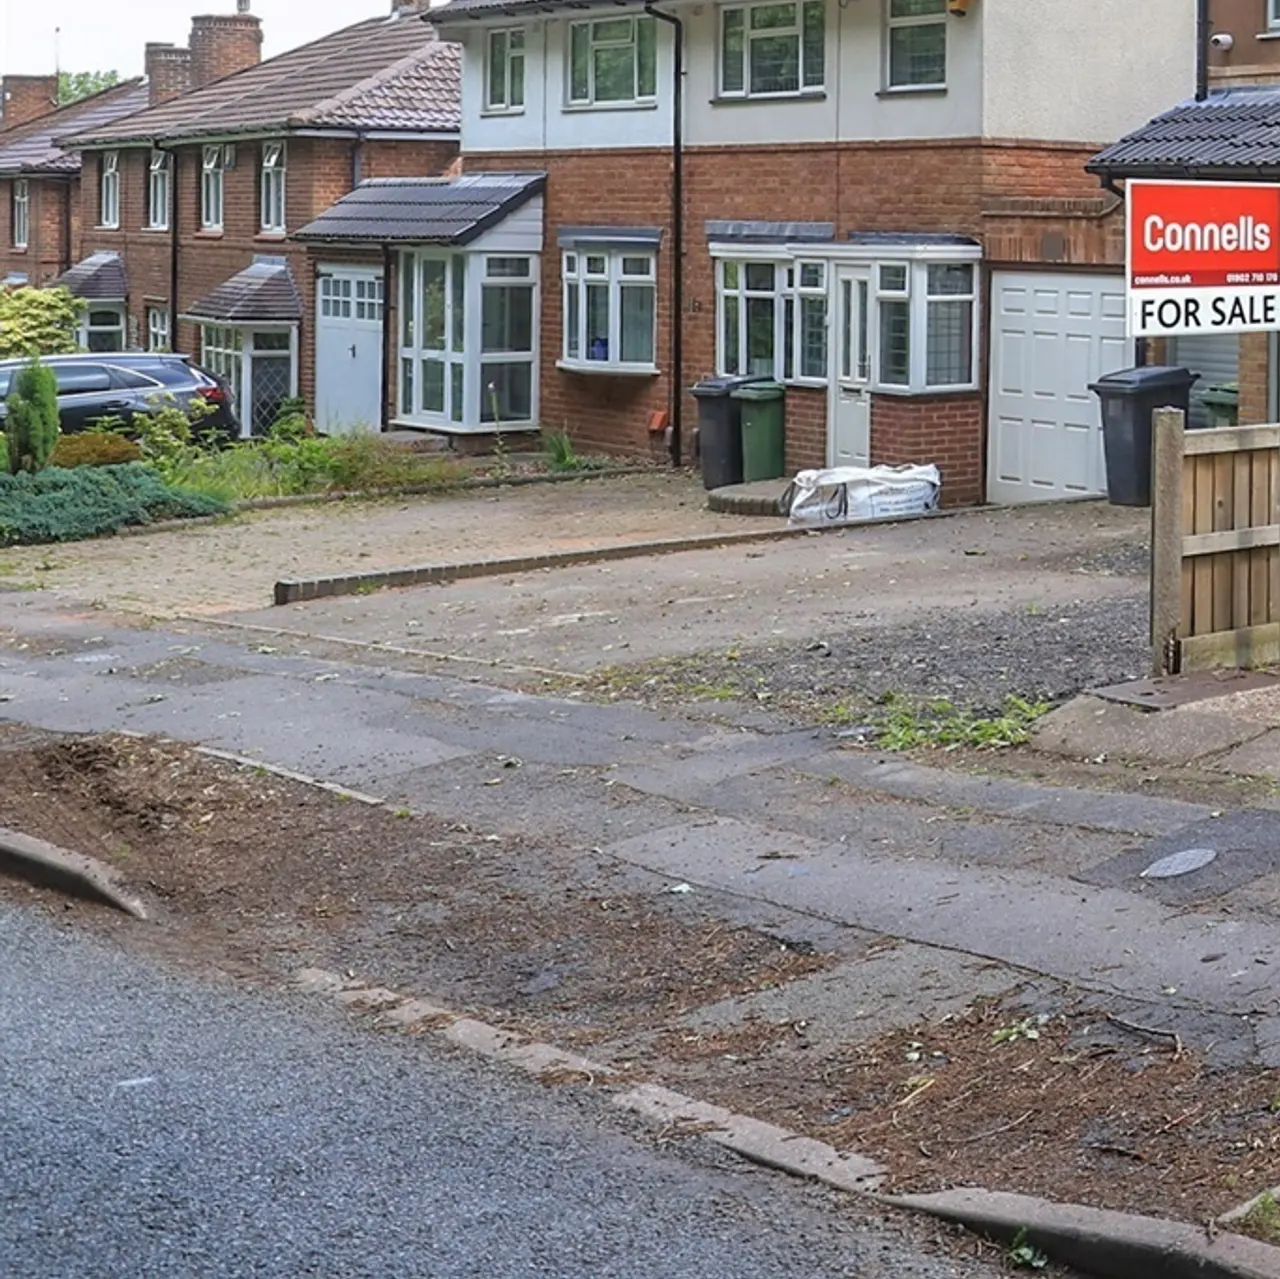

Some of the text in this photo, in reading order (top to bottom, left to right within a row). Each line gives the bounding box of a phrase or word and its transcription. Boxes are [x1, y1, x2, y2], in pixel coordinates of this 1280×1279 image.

[1144, 214, 1271, 252] Connells
[1134, 274, 1192, 285] connells.co.uk
[1141, 295, 1276, 329] FOR SALE
